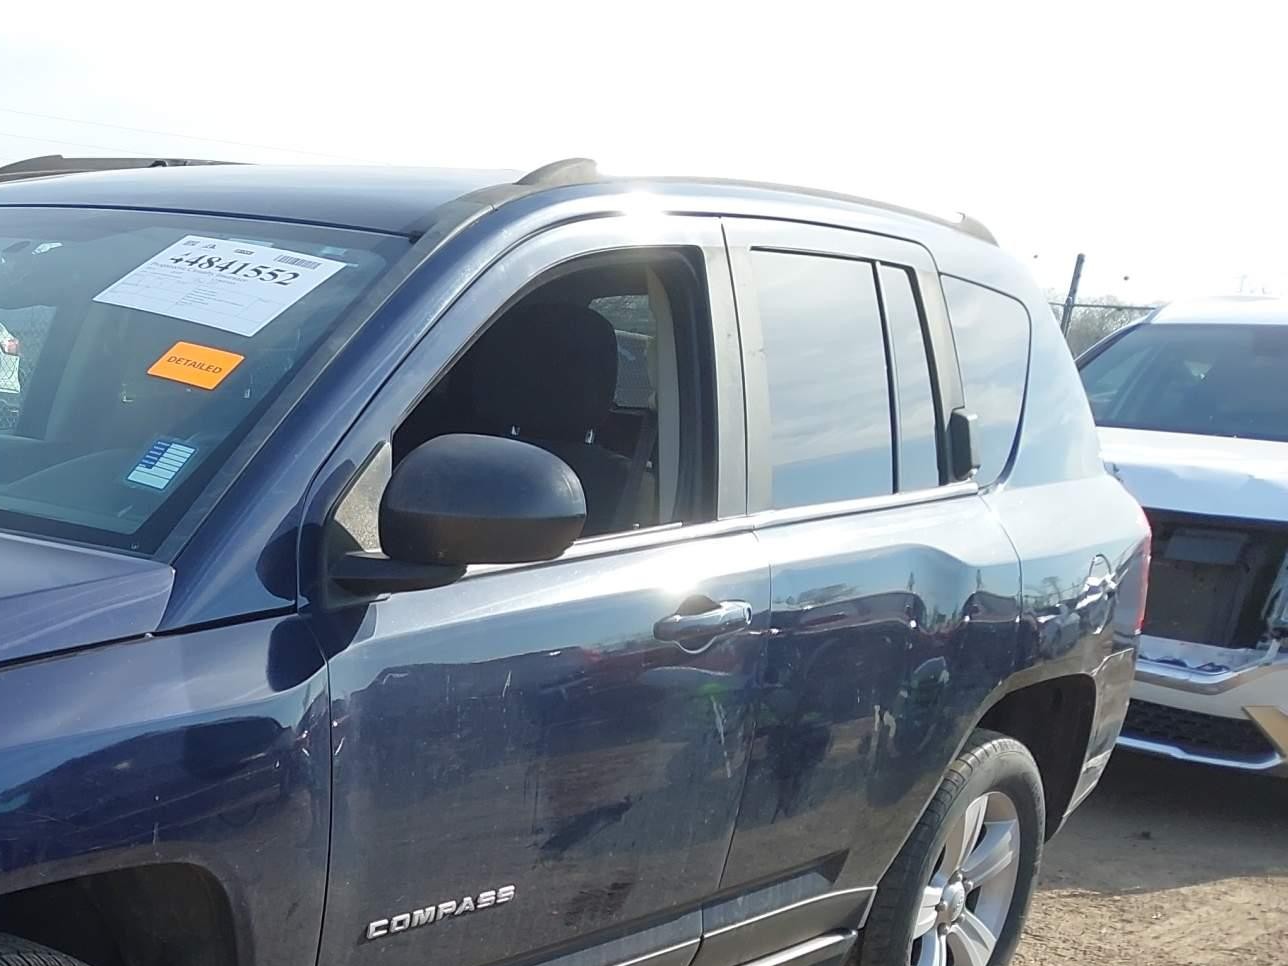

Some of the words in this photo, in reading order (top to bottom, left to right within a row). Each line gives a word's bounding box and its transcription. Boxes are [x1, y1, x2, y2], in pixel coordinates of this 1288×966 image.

[170, 253, 300, 286] 44841552
[167, 355, 223, 374] DETAILED
[366, 885, 516, 940] COMPASS
